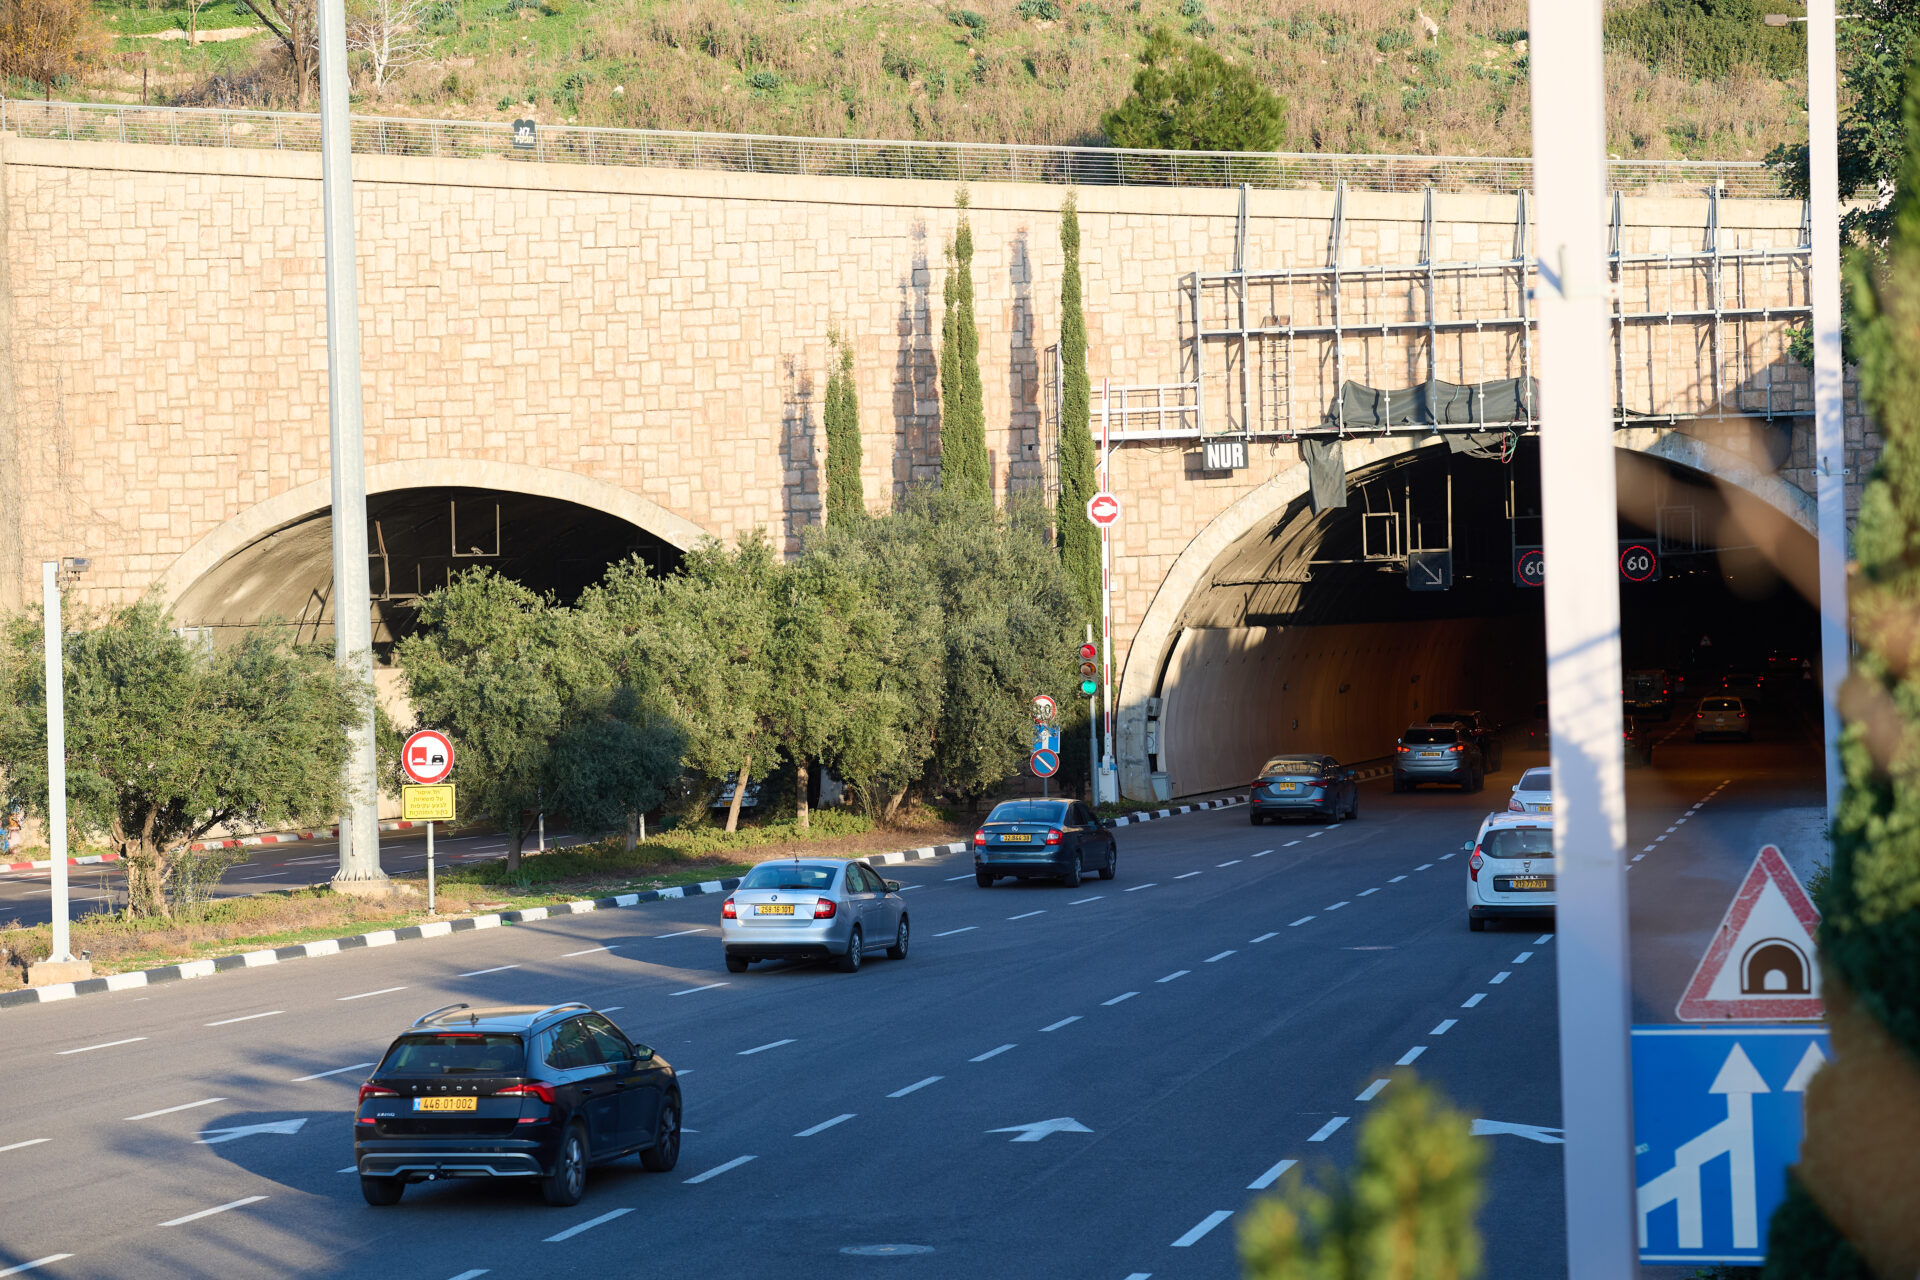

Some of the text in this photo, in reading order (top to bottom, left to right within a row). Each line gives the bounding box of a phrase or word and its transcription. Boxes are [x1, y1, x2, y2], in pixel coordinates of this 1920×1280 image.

[1207, 443, 1244, 468] NUR
[1525, 561, 1545, 576] 60
[1627, 556, 1649, 571] 60
